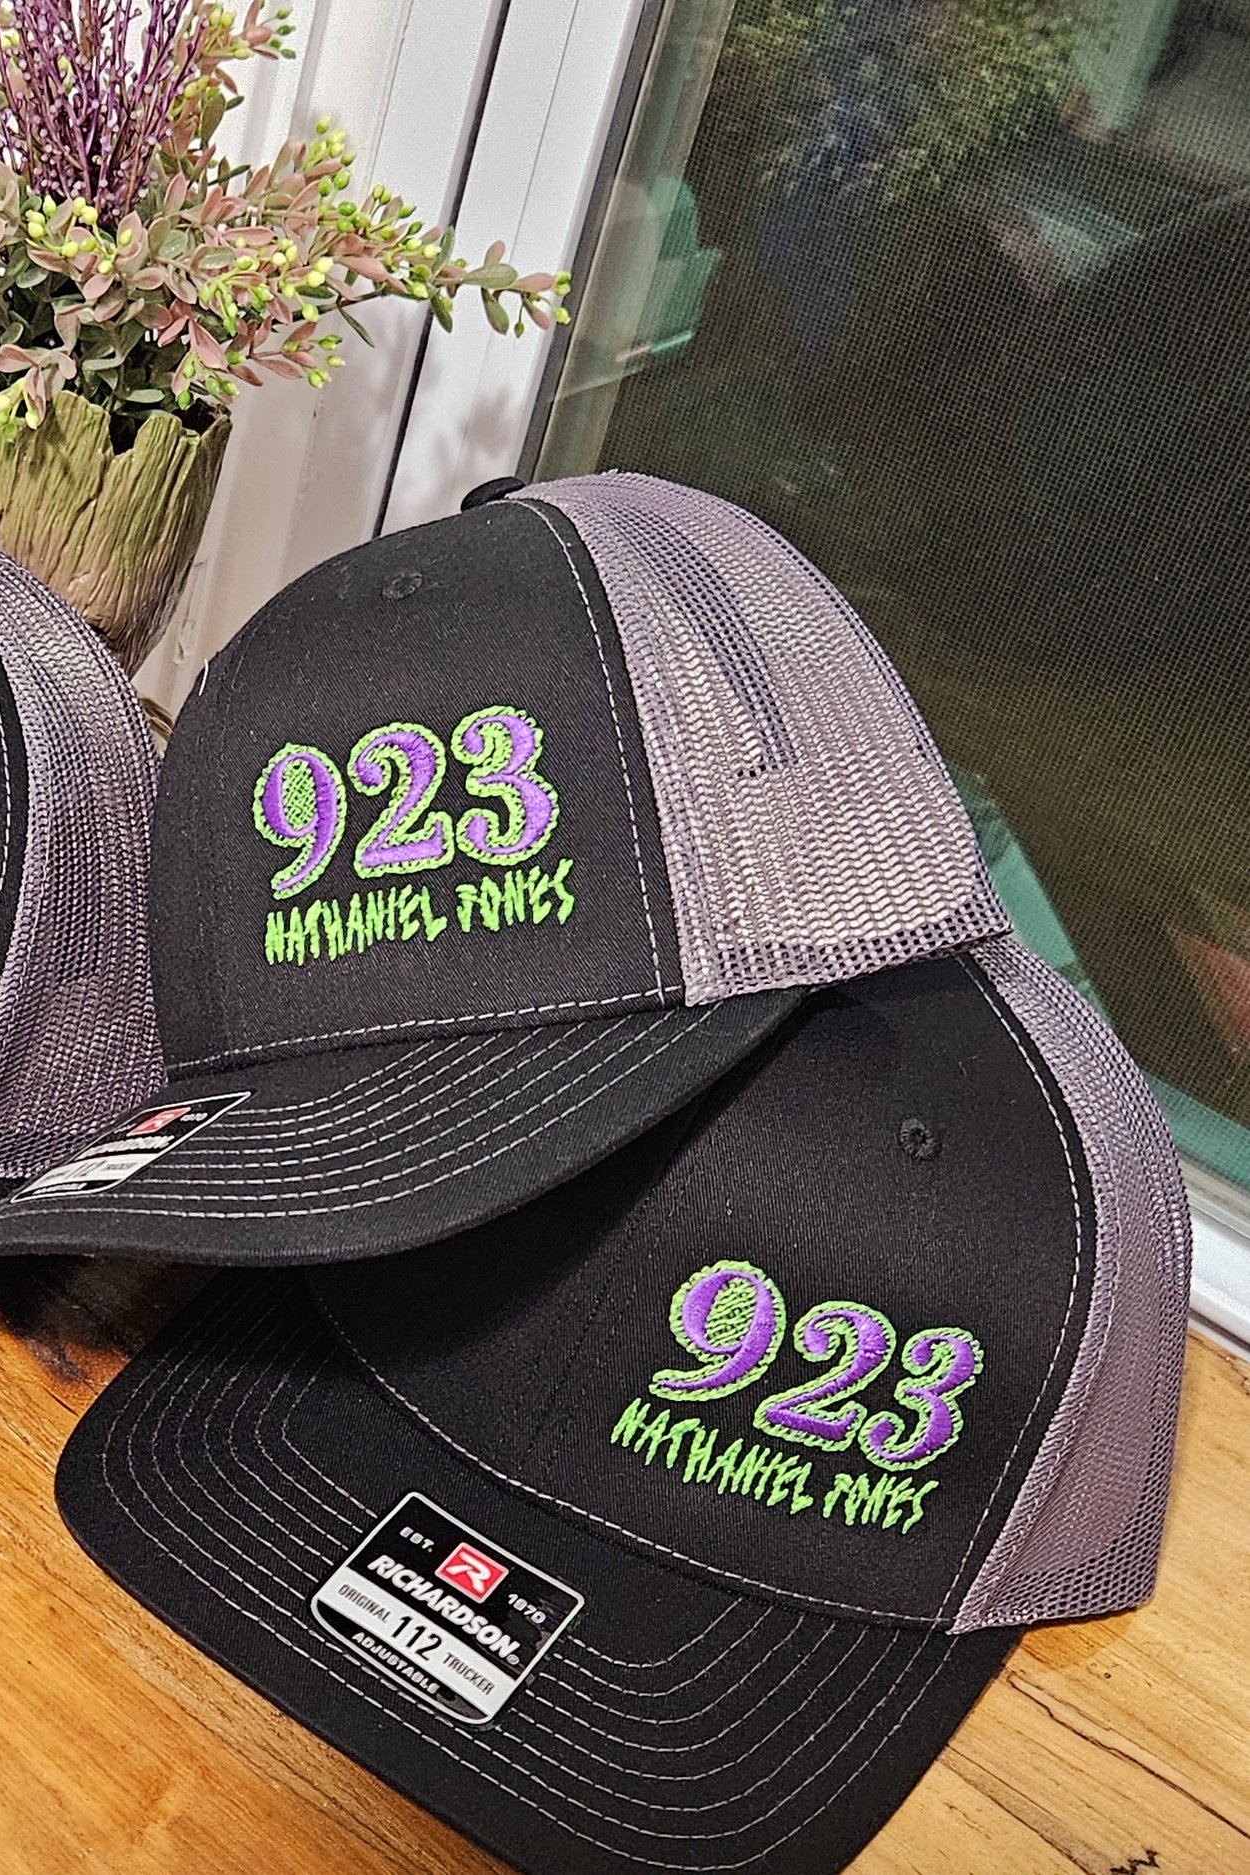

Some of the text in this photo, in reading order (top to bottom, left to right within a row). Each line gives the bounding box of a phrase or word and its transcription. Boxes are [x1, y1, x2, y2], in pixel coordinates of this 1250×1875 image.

[252, 705, 560, 900] 923
[264, 858, 575, 966] NATHANIEL JONES
[649, 1259, 984, 1472] 923
[610, 1397, 939, 1534] NATHANIEL JONES
[338, 1583, 496, 1696] ORIGINAL 112 TRUCKER
